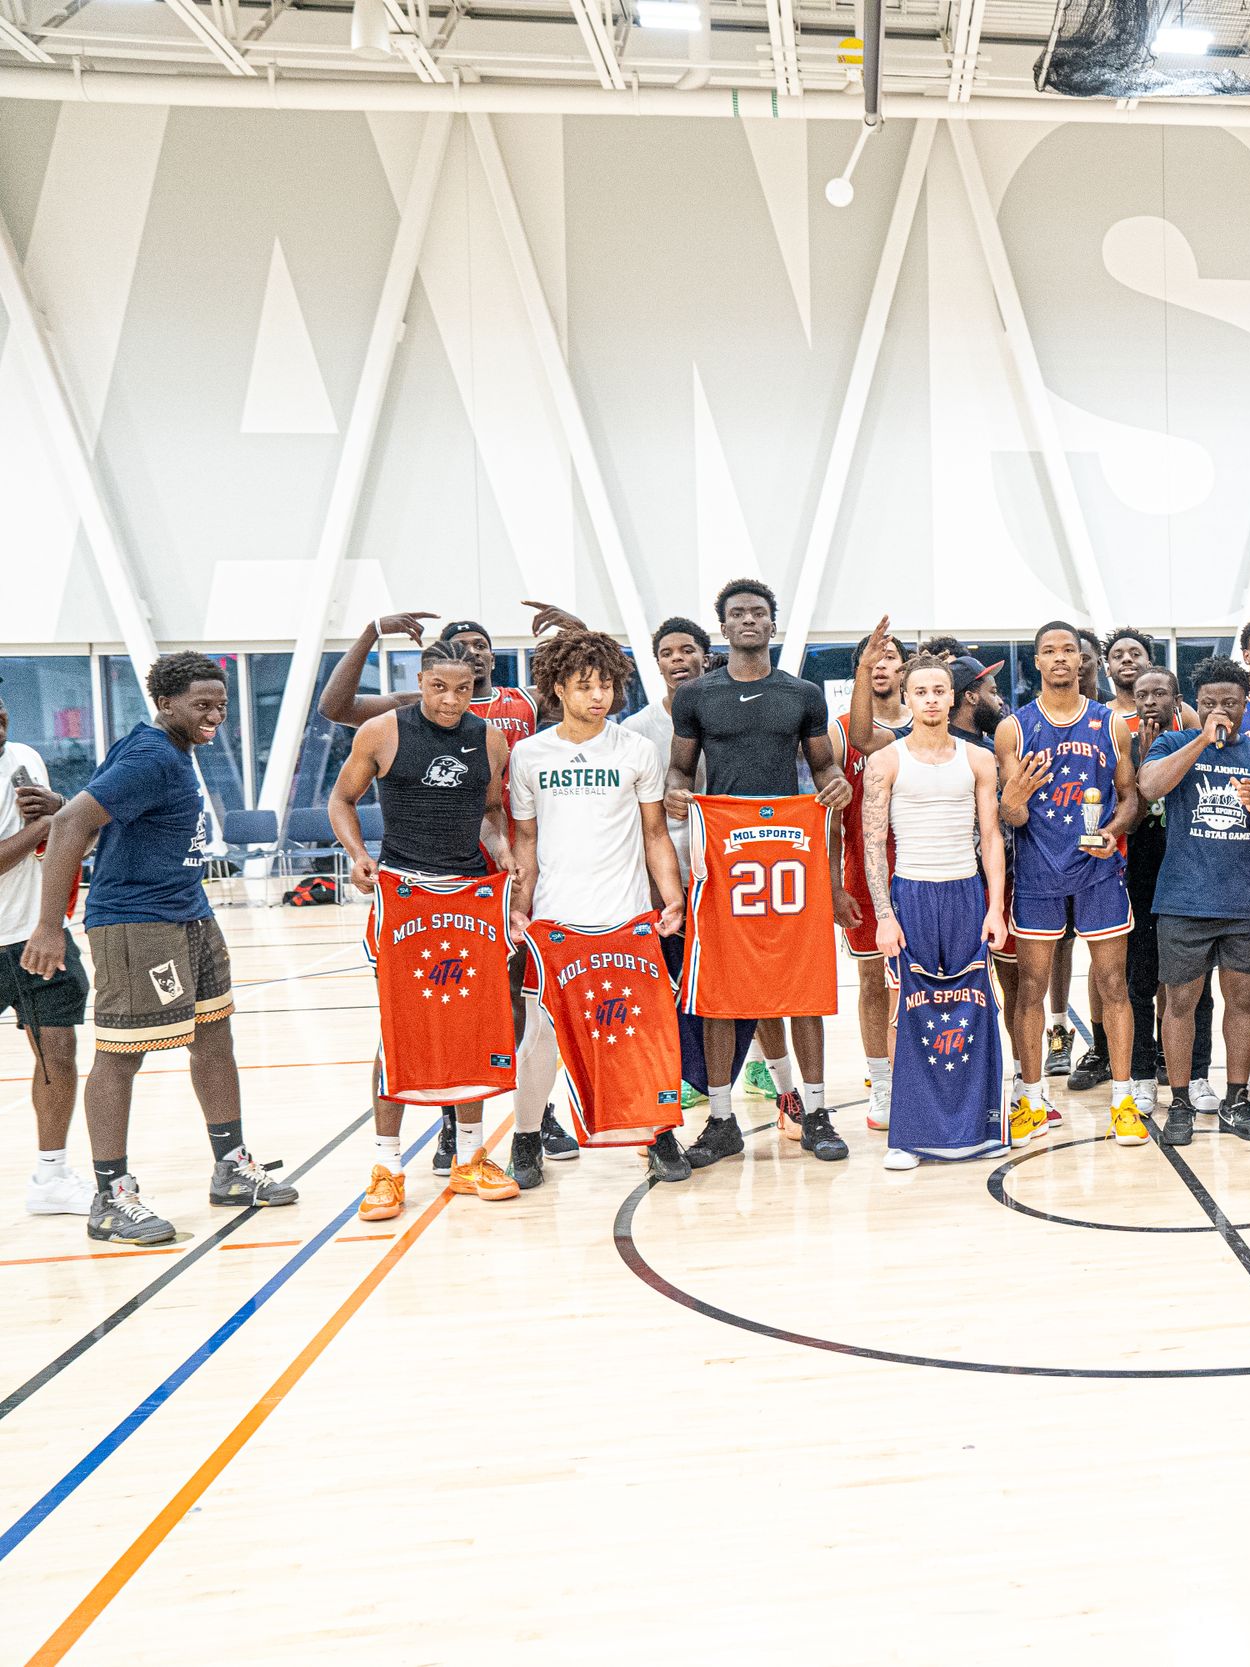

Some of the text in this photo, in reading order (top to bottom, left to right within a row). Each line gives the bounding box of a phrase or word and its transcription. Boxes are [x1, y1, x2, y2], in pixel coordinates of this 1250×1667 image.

[484, 717, 530, 736] PORTS
[538, 768, 620, 790] EASTERN
[1195, 762, 1250, 776] 3RD ANNUAL
[552, 787, 607, 797] BASKETBALL
[1052, 781, 1084, 808] 4T4
[733, 829, 802, 841] MOL SPORTS
[1190, 827, 1250, 841] ALL STAR GAME
[729, 858, 806, 917] 20
[392, 912, 497, 945] MOL SPORTS
[428, 958, 464, 986] 4T4
[556, 952, 659, 989] MOL SPORTS
[595, 998, 627, 1026] 4T4
[905, 987, 987, 1012] MOL SPORTS
[932, 1027, 965, 1056] 4T4
